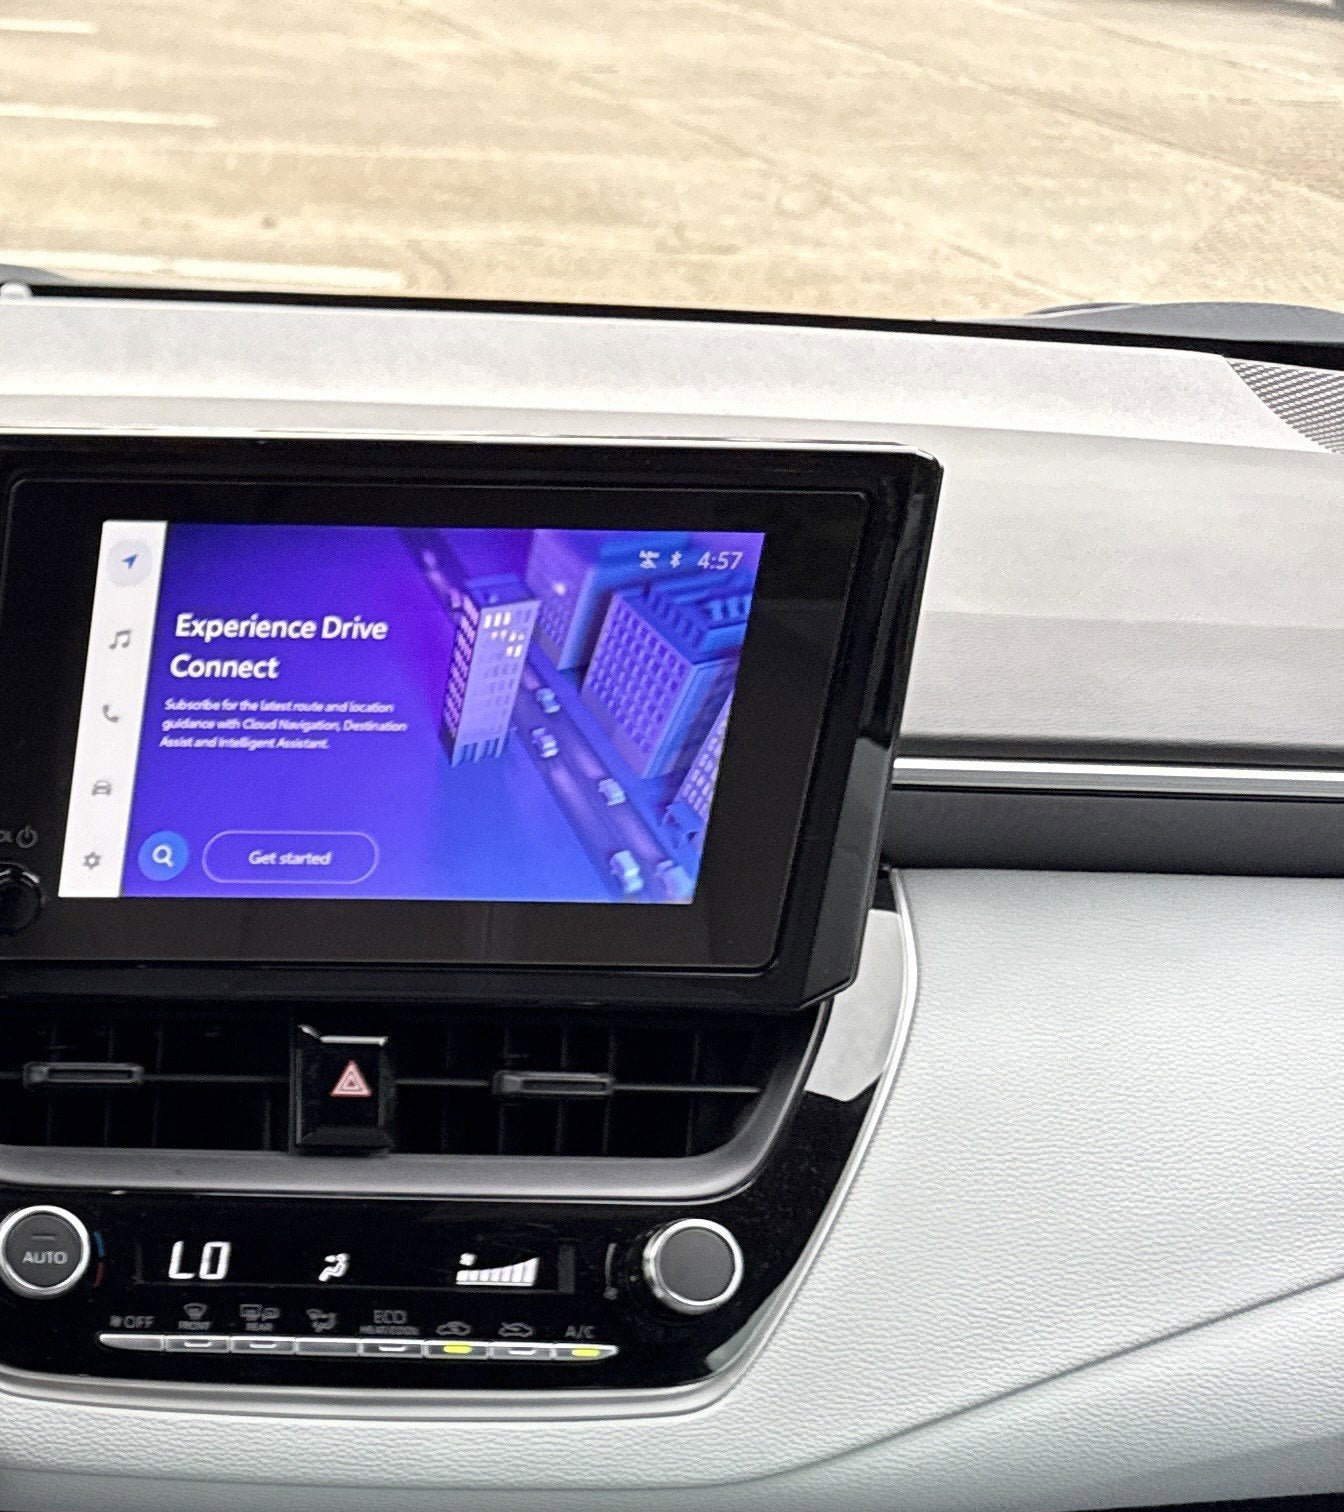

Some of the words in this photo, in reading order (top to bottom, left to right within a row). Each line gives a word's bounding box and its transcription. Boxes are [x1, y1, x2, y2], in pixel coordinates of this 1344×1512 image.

[697, 551, 744, 570] 4:57
[175, 612, 317, 643] Experience
[321, 615, 389, 640] Drive
[170, 653, 280, 679] Connect
[164, 698, 220, 711] Subscribe
[221, 698, 239, 711] for
[239, 699, 259, 711] the
[260, 700, 292, 712] latest
[293, 701, 324, 712] route
[324, 701, 348, 713] and
[349, 701, 395, 713] location
[161, 718, 215, 731] guidance
[216, 718, 241, 729] with
[242, 718, 277, 730] Cloud
[342, 719, 408, 732] Destination
[158, 736, 193, 748] Assist
[193, 736, 217, 748] and
[248, 849, 278, 865] Get
[278, 851, 333, 865] started
[22, 1251, 68, 1266] AUTO
[168, 1241, 232, 1280] LO
[123, 1315, 155, 1329] OFF
[564, 1325, 595, 1340] A/C
